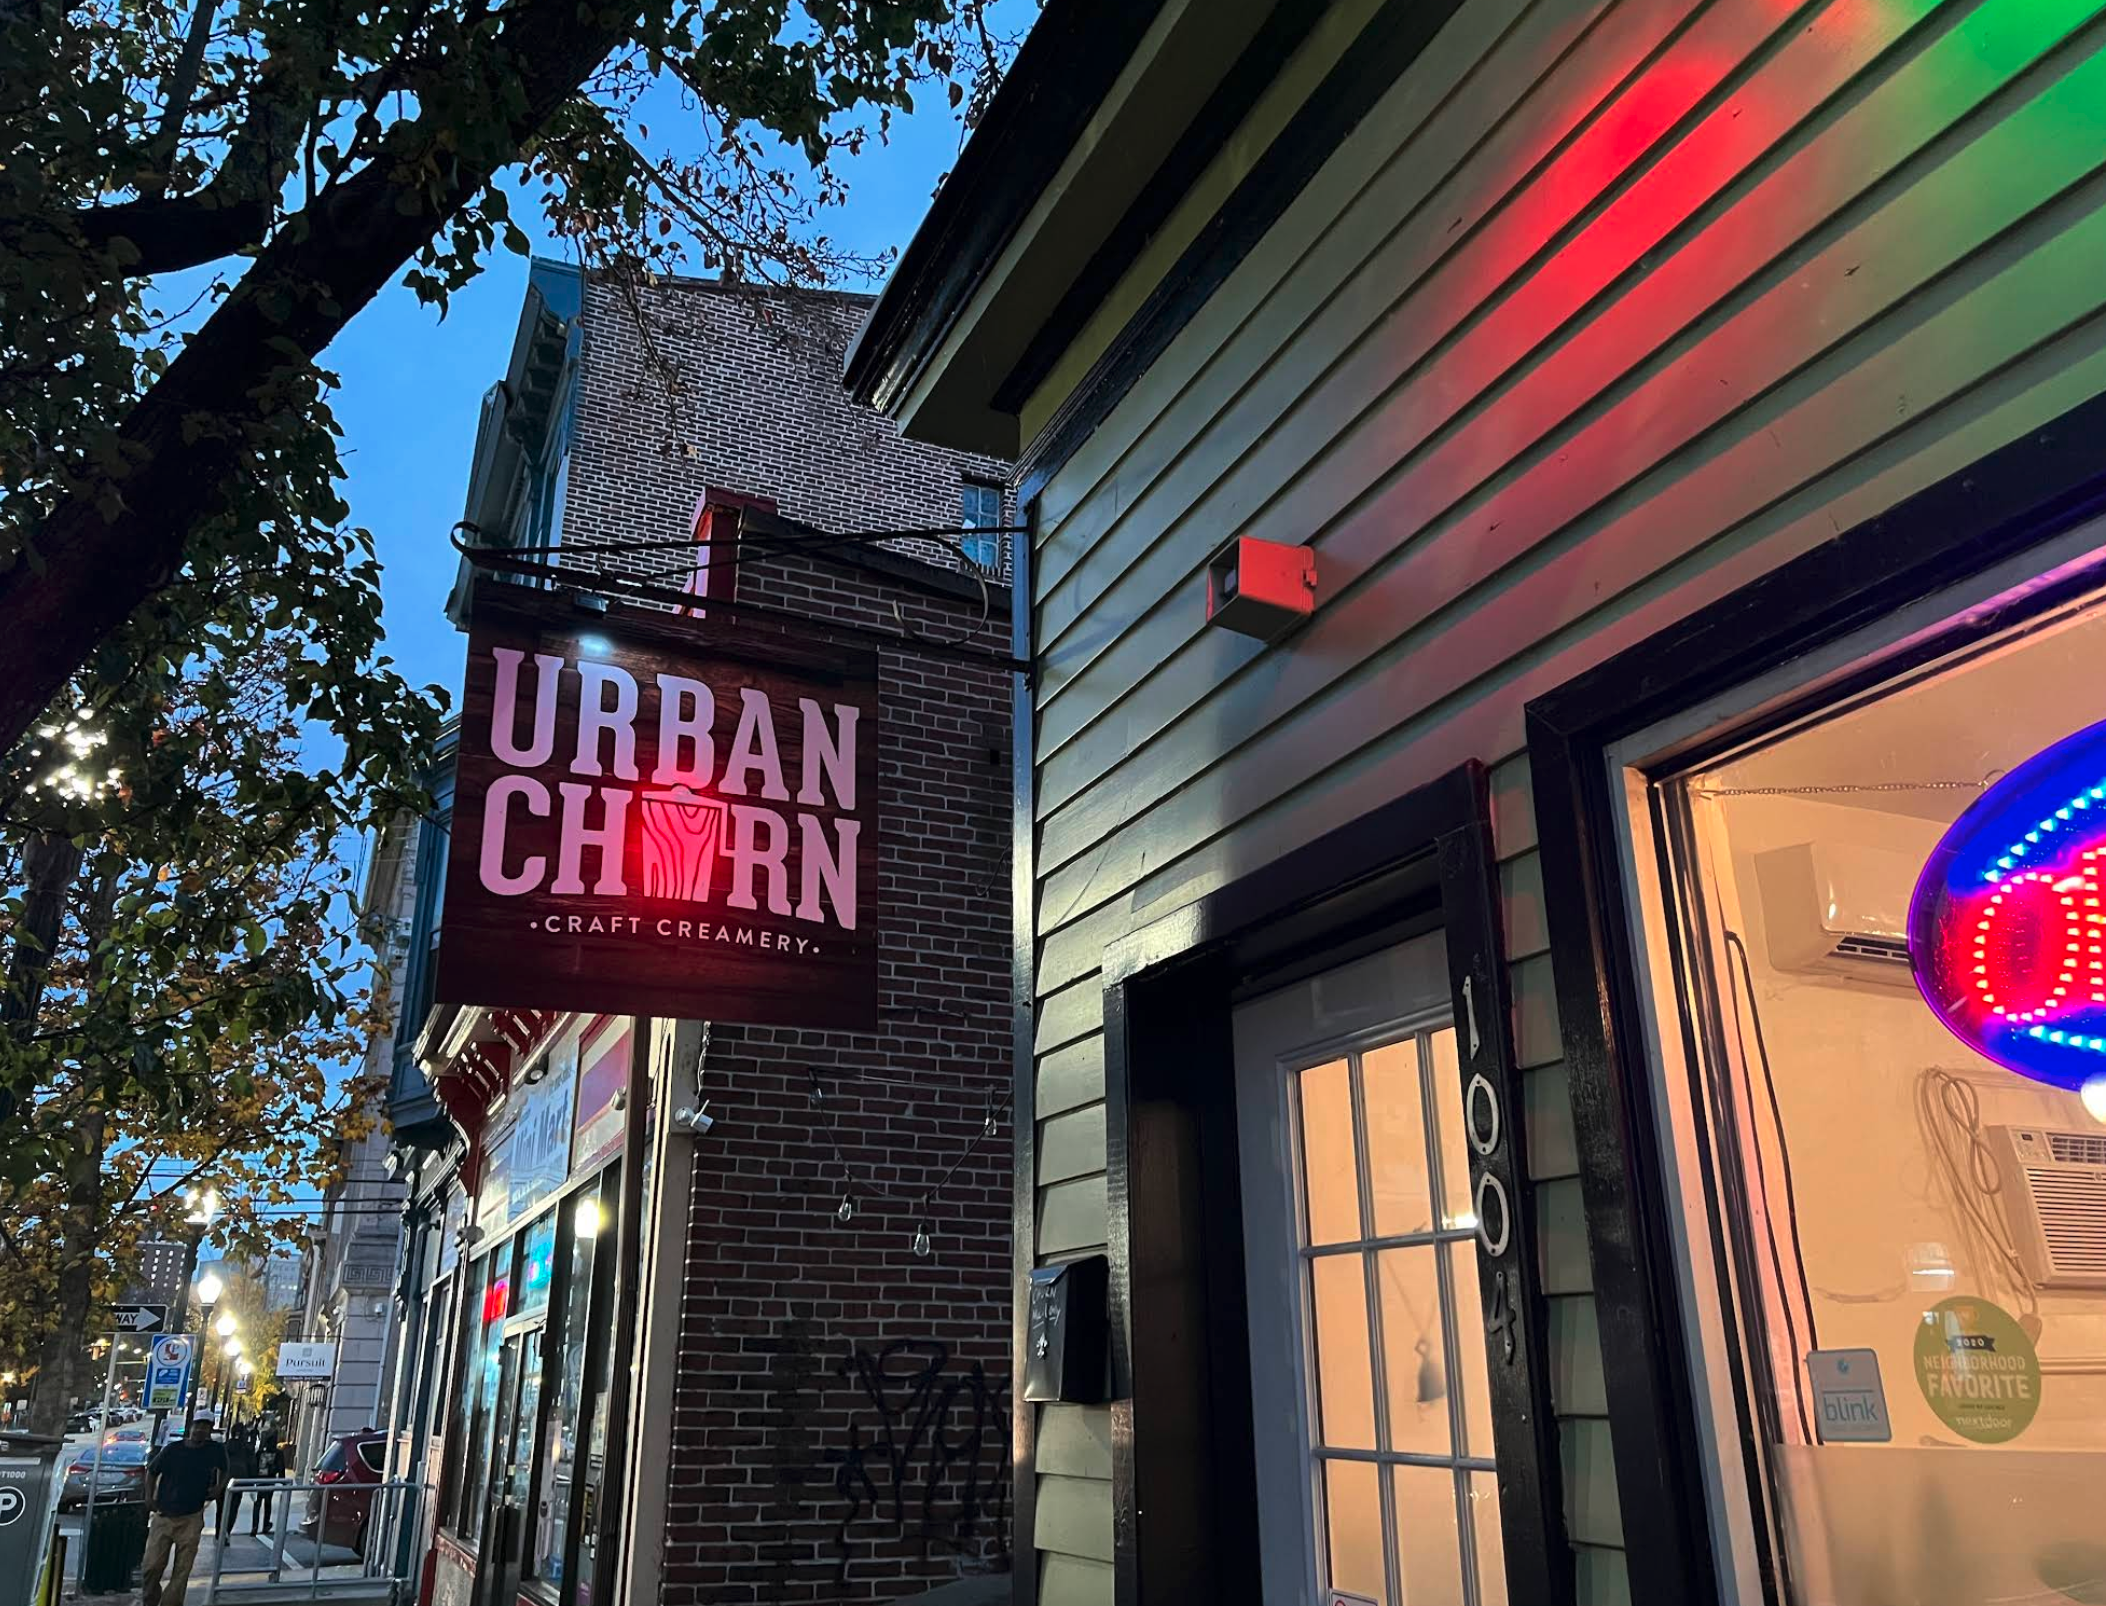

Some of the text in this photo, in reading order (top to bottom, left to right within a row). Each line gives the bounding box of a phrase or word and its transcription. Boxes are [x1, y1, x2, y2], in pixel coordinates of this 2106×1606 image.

[490, 647, 860, 811] URBAN
[544, 915, 809, 955] CRAFT CREAMERY
[286, 1358, 325, 1368] Pursuit
[1926, 1373, 2032, 1399] FAVORITE
[1823, 1396, 1879, 1421] blink
